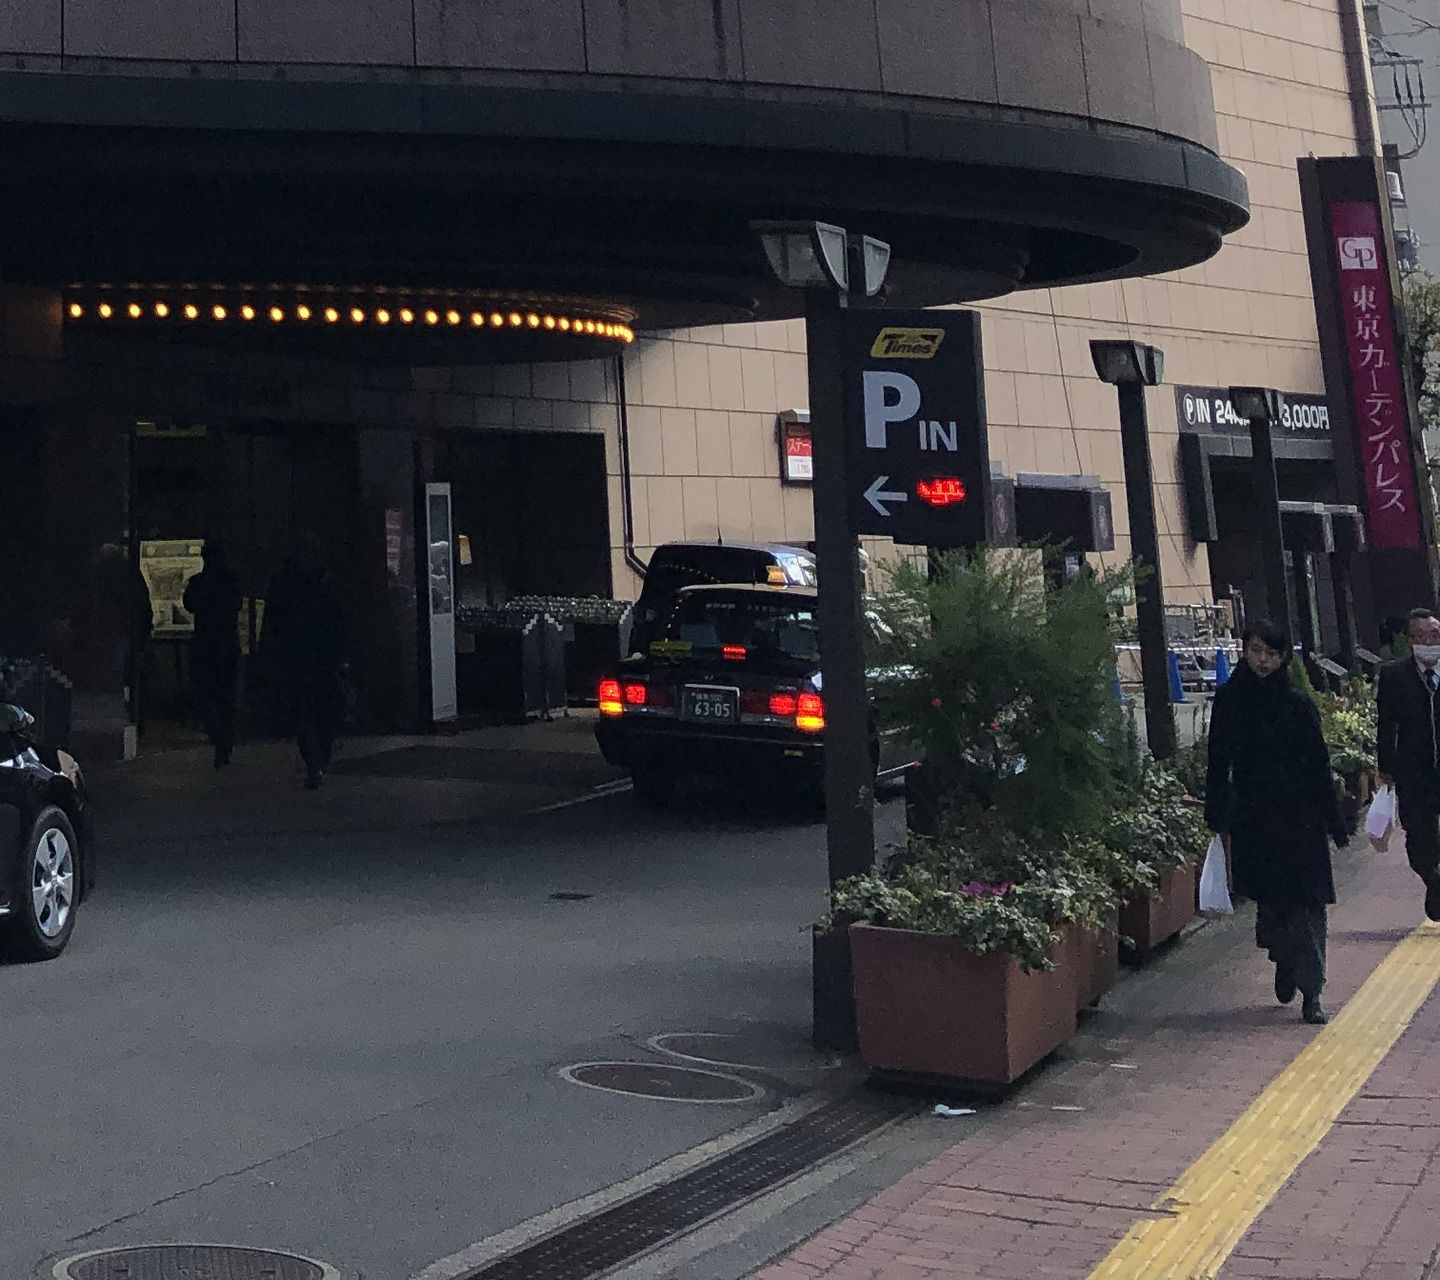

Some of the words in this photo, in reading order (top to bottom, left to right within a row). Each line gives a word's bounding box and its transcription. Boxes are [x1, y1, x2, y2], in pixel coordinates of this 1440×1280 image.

[884, 339, 931, 355] Times
[863, 370, 921, 449] P
[919, 419, 958, 452] IN
[1195, 397, 1211, 424] IN
[1282, 403, 1330, 430] 3,000円
[1353, 285, 1406, 513] 東京ガーデンパレス
